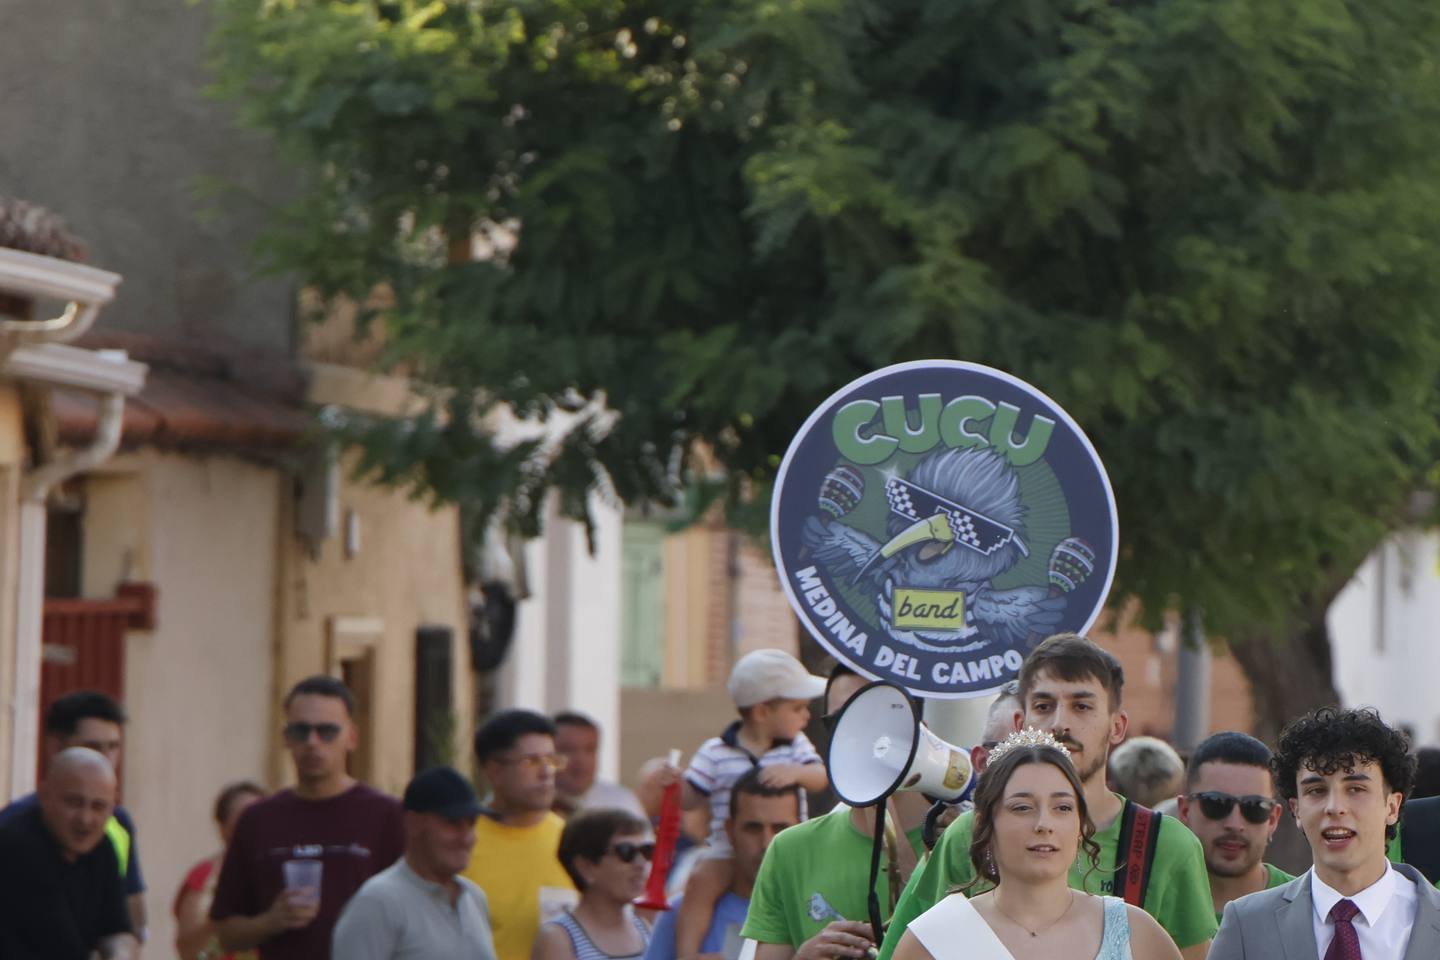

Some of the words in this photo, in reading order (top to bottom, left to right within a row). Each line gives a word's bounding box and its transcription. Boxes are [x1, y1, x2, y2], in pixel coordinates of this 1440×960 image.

[831, 393, 1056, 466] CUCU
[795, 565, 869, 657] MEDINA
[873, 645, 921, 681] DEL
[932, 649, 1024, 684] CAMPO
[897, 595, 960, 620] band
